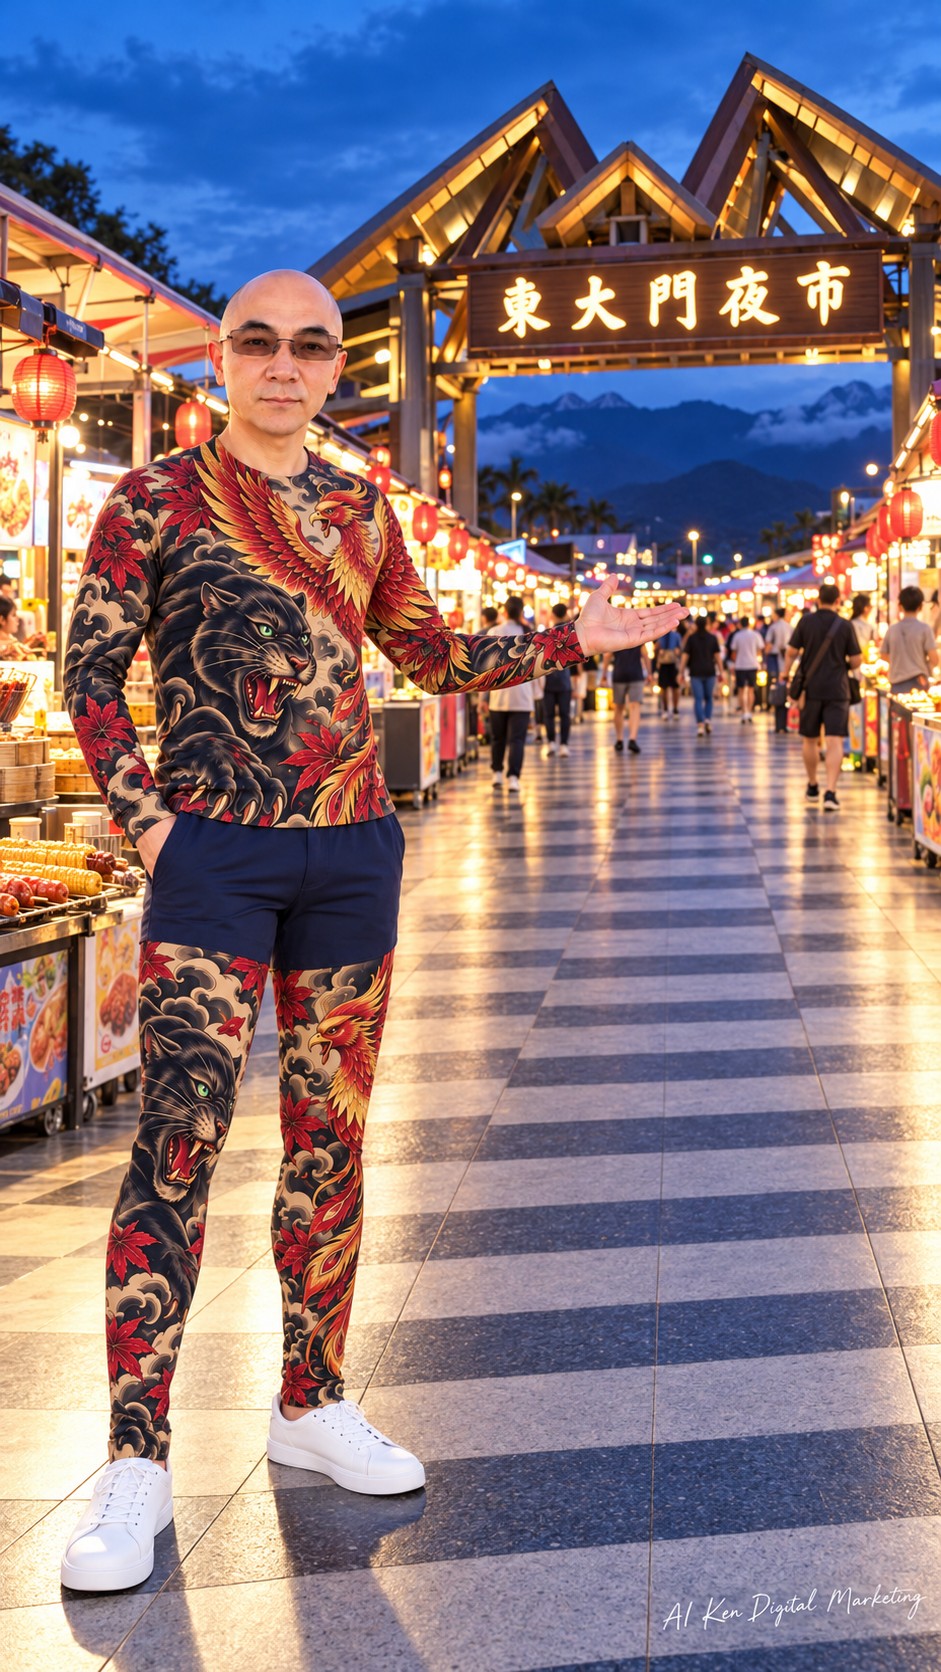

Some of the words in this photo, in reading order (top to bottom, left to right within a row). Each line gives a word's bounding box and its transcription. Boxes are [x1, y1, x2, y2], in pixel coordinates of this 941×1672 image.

[498, 260, 851, 339] 東大門夜市
